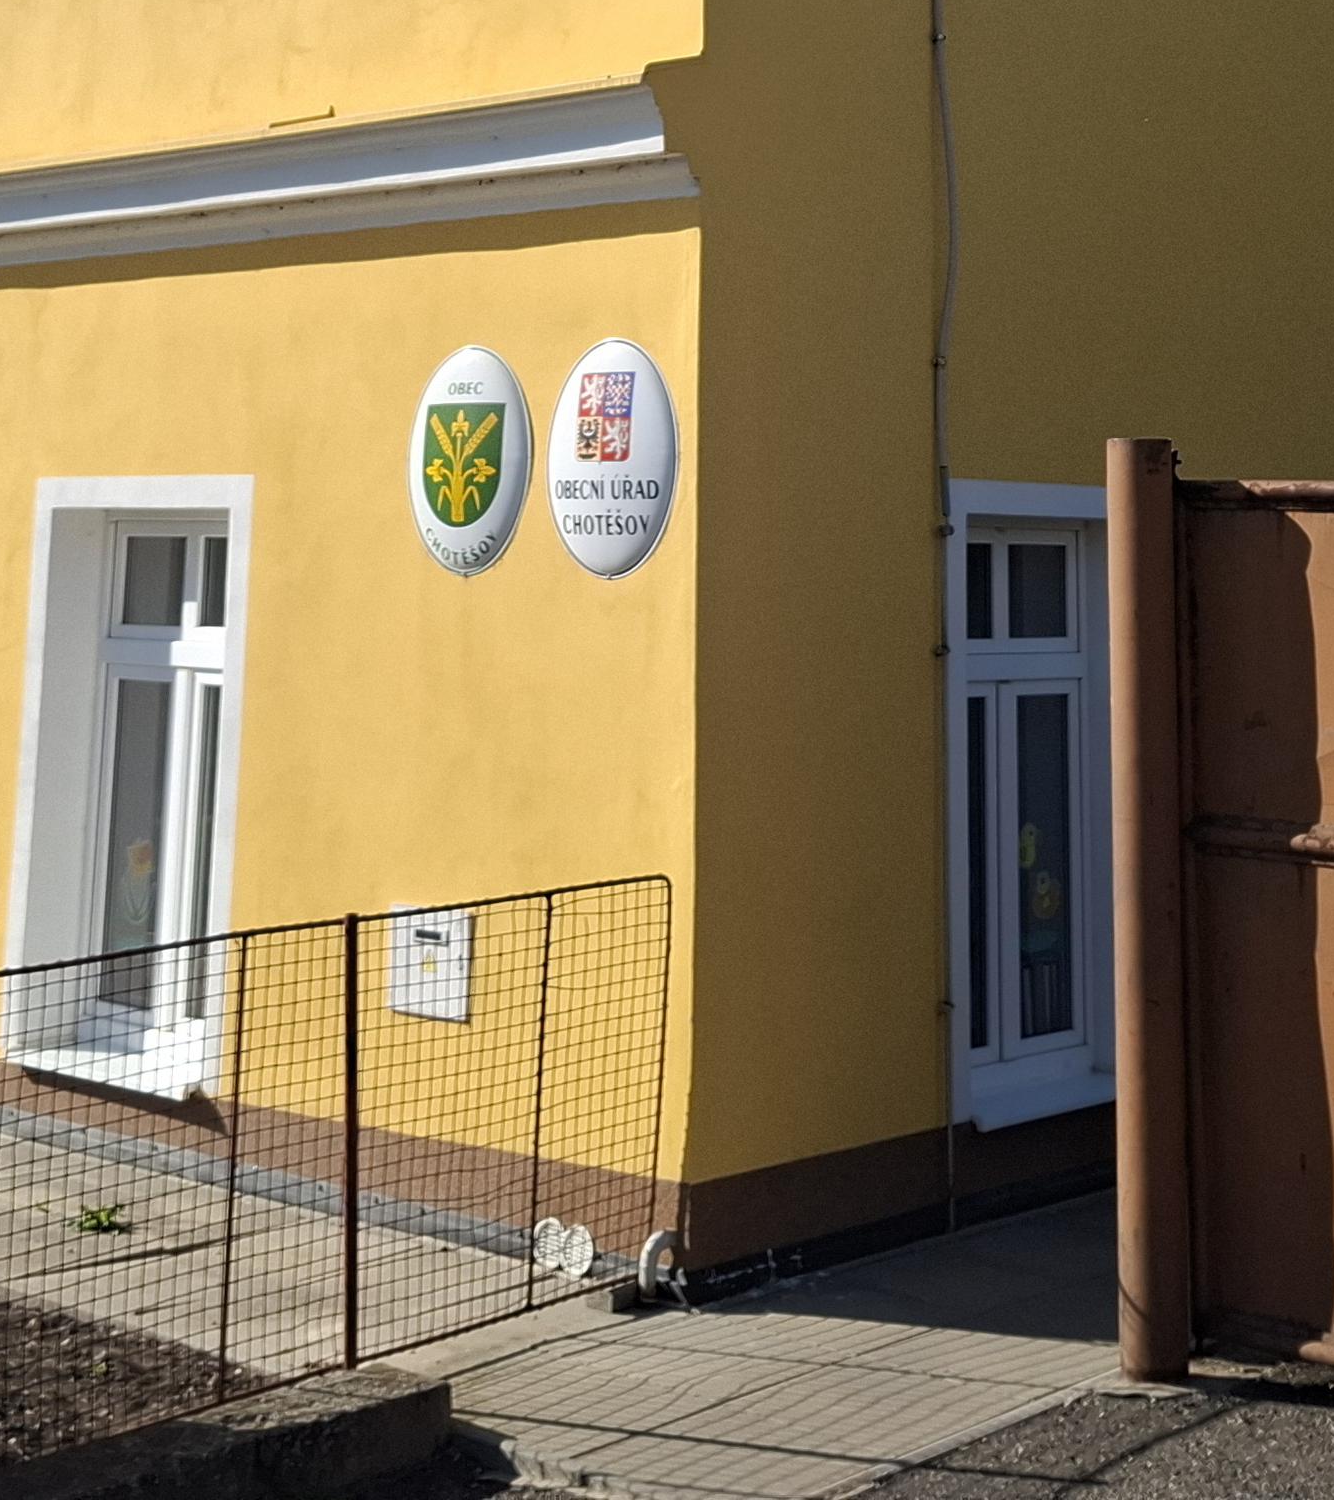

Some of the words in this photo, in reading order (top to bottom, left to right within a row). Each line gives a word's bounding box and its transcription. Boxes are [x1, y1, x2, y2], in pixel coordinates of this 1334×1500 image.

[447, 381, 484, 396] OBEC
[554, 473, 605, 500] OBECNÍ
[610, 473, 660, 500] ÚŘAD
[562, 508, 650, 536] CHOTĚŠOV
[425, 527, 498, 565] CHOTĚŠOV
